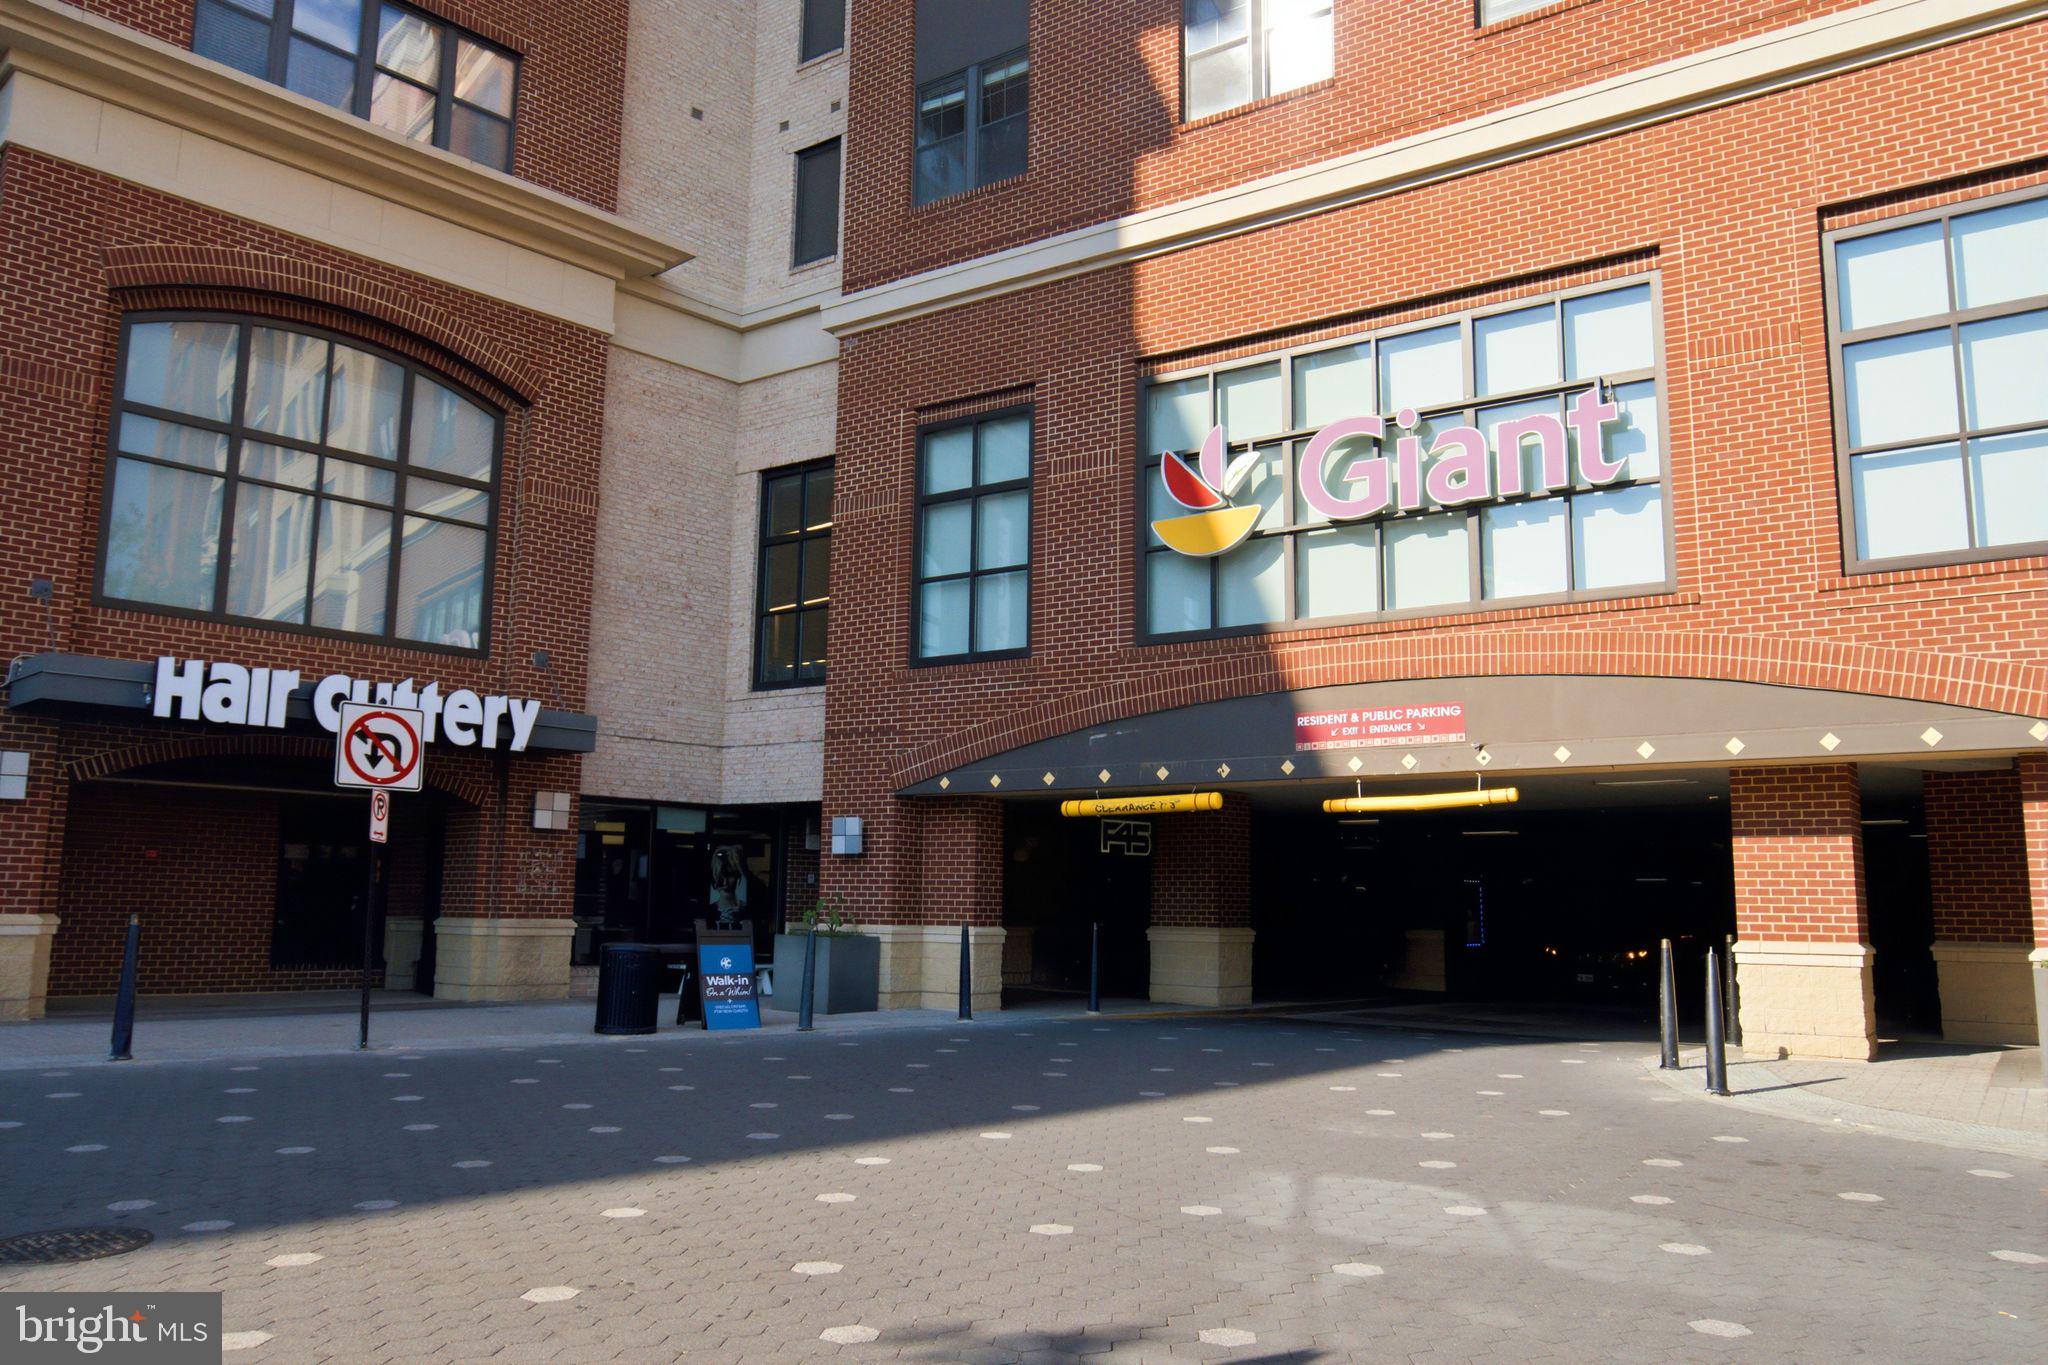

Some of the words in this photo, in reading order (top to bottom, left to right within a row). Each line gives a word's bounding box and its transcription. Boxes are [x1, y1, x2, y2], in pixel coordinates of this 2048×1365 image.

[1300, 388, 1627, 520] Giant
[153, 656, 299, 728] Hair
[1297, 713, 1348, 727] RESIDENT
[1350, 712, 1359, 723] &
[1362, 709, 1403, 722] PUBLIC
[1406, 705, 1462, 719] PARKING
[1342, 726, 1358, 736] EXIT
[1369, 722, 1413, 734] ENTRANCE
[1095, 801, 1156, 813] CLEARANCE
[1101, 819, 1151, 856] F45
[706, 975, 749, 986] Walk-in
